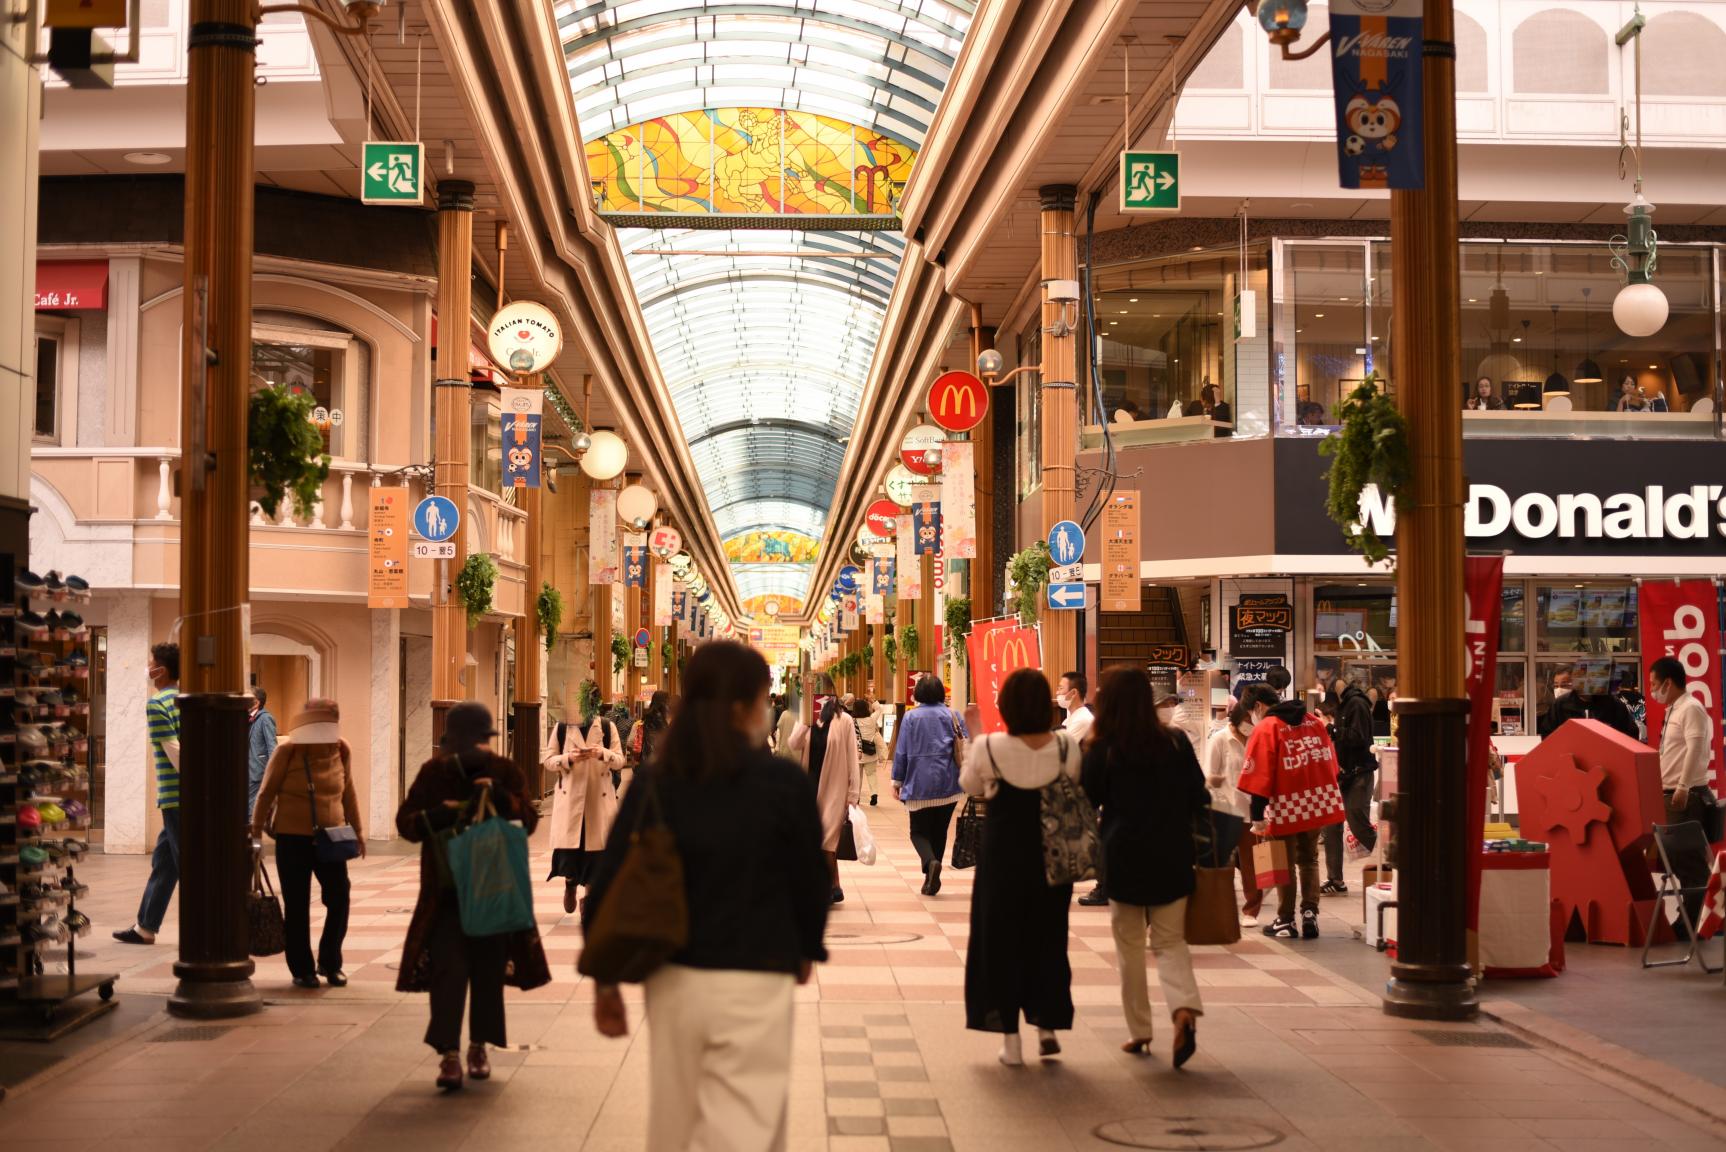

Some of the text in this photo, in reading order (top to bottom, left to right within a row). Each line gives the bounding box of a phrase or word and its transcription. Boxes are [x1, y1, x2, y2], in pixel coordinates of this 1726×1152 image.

[1352, 49, 1408, 58] NAGASAKI
[34, 292, 79, 305] Café Jr.
[494, 319, 555, 338] ITALIAN TOMATO
[1240, 610, 1287, 626] 夜マック
[1237, 661, 1279, 670] ナイトクルー
[1473, 641, 1487, 683] NTT
[1284, 736, 1322, 755] ドコモの
[1282, 746, 1333, 770] ロング学割
